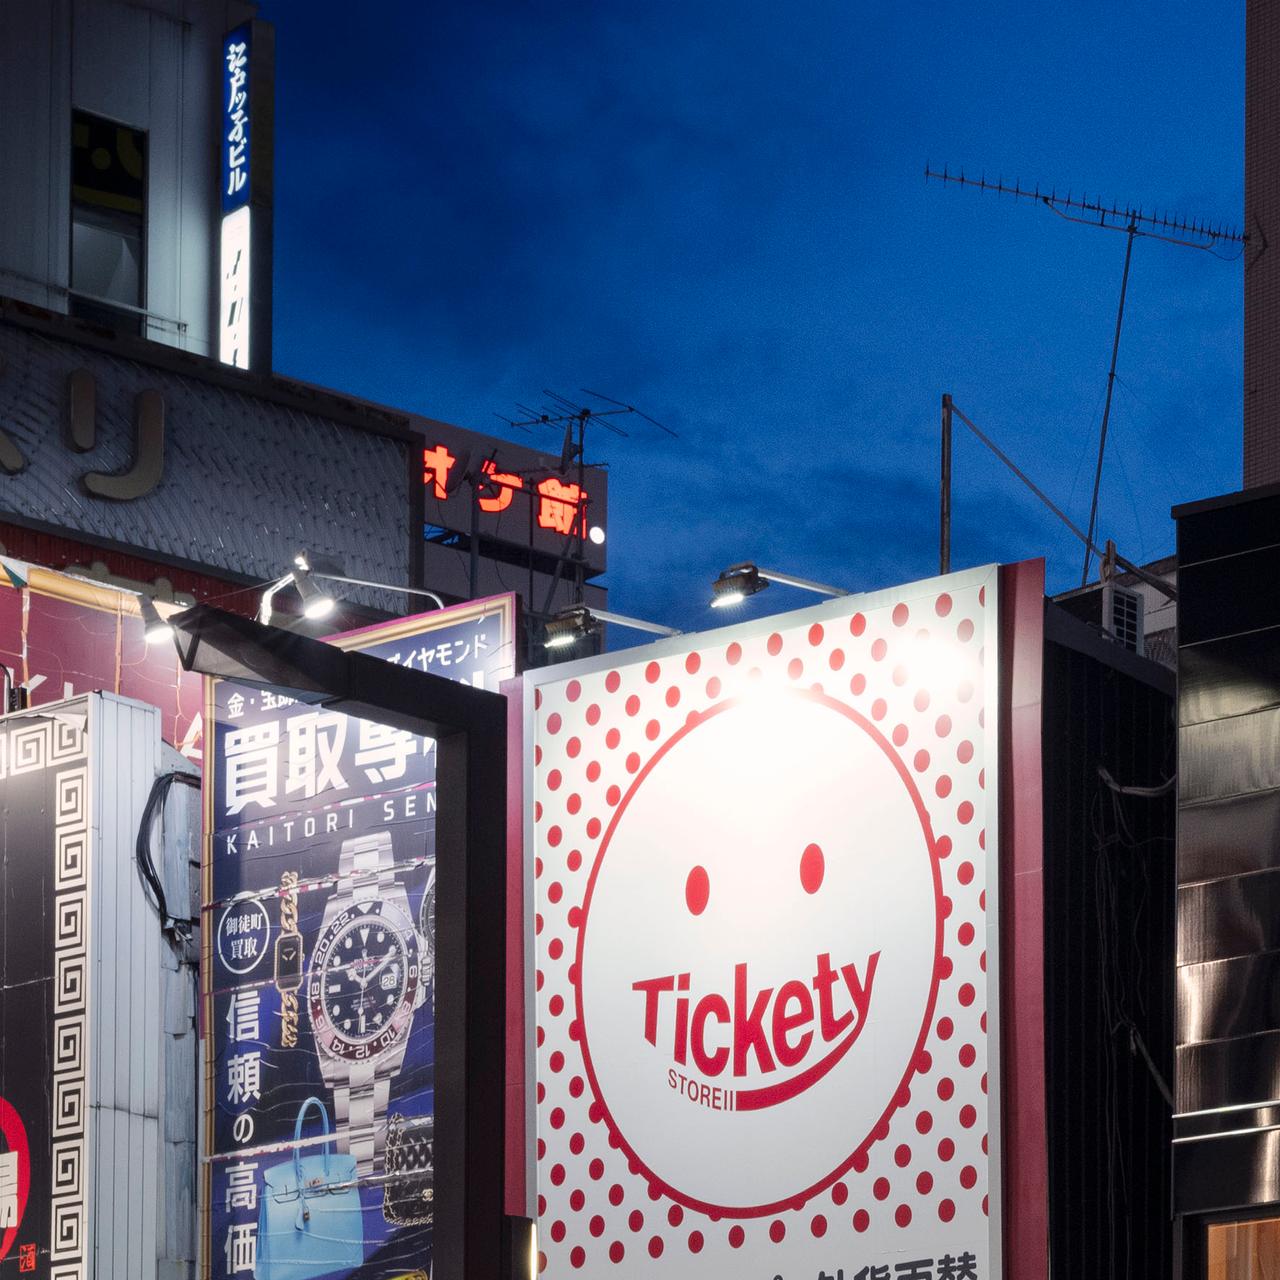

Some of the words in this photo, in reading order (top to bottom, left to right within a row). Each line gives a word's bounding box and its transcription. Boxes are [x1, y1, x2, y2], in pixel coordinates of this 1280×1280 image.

[224, 710, 438, 816] 買取専
[226, 809, 355, 855] KAITORI
[226, 912, 264, 938] 御徒町
[231, 937, 258, 961] 買取
[631, 950, 882, 1078] Tickety
